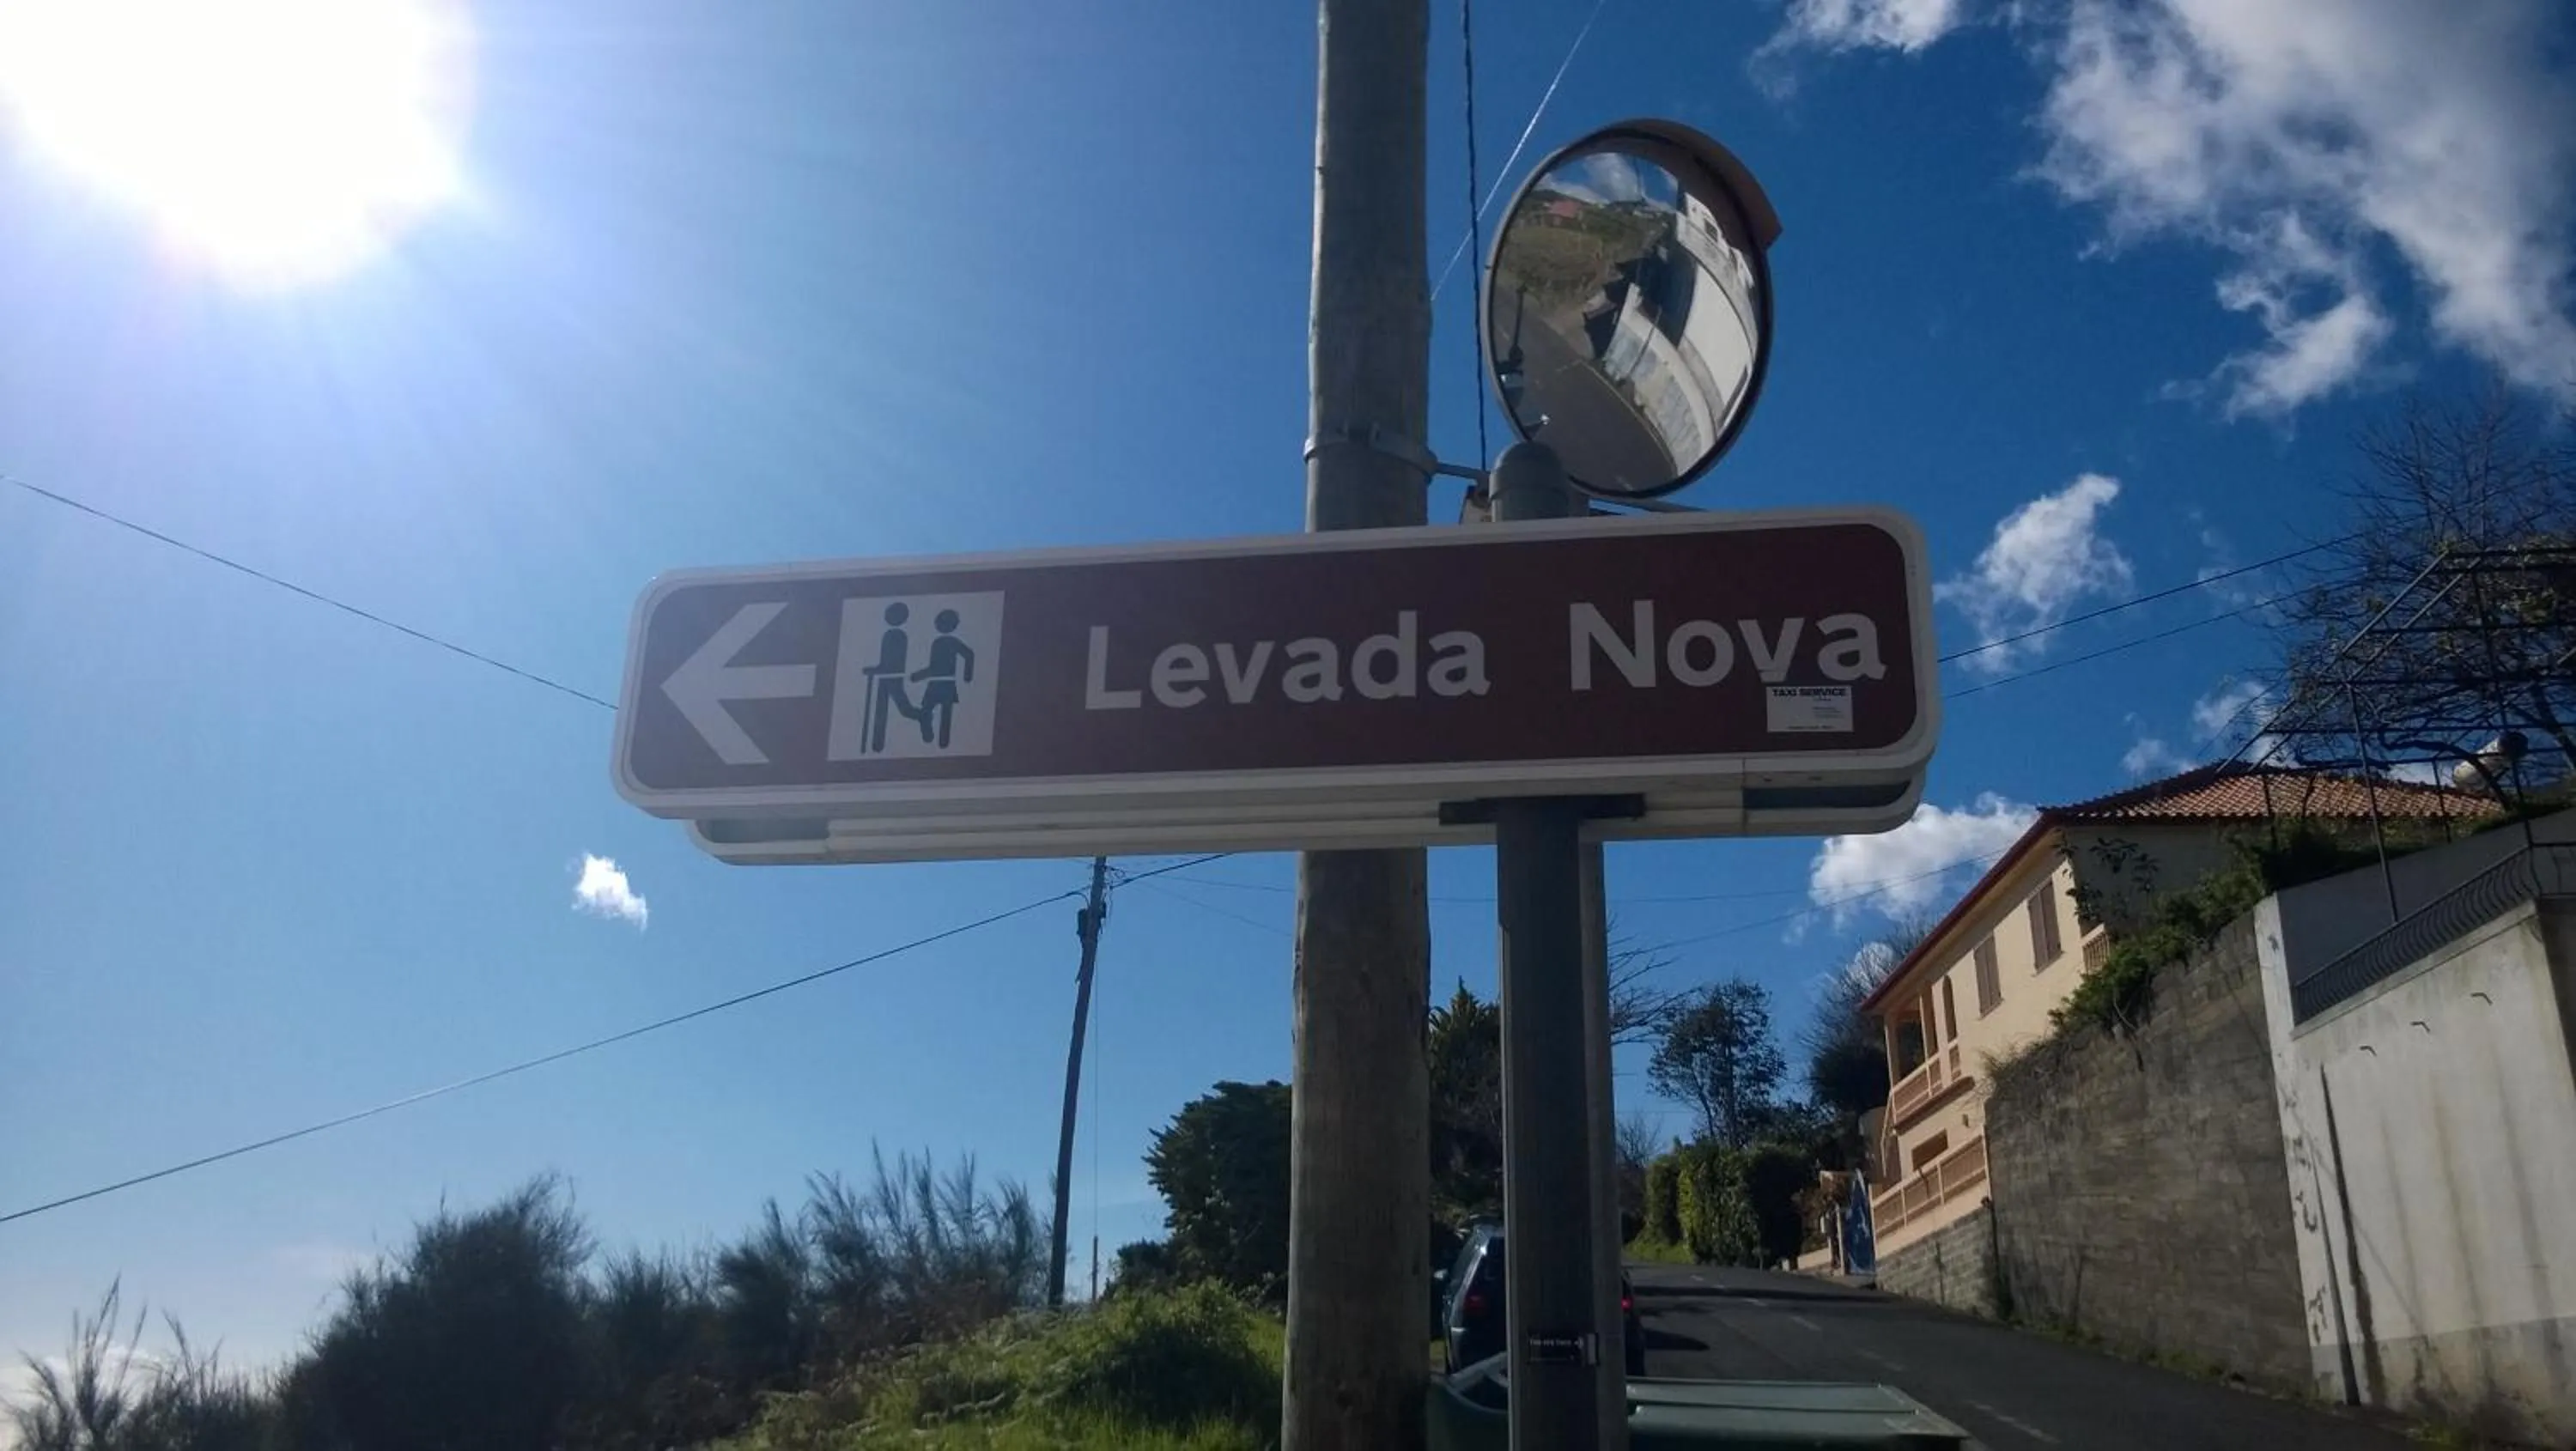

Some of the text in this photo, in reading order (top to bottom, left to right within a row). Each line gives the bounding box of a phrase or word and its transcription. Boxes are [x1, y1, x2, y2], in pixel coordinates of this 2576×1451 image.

[1085, 600, 1886, 709] Levada Nova
[1771, 687, 1846, 696] TAXI SERVICE
